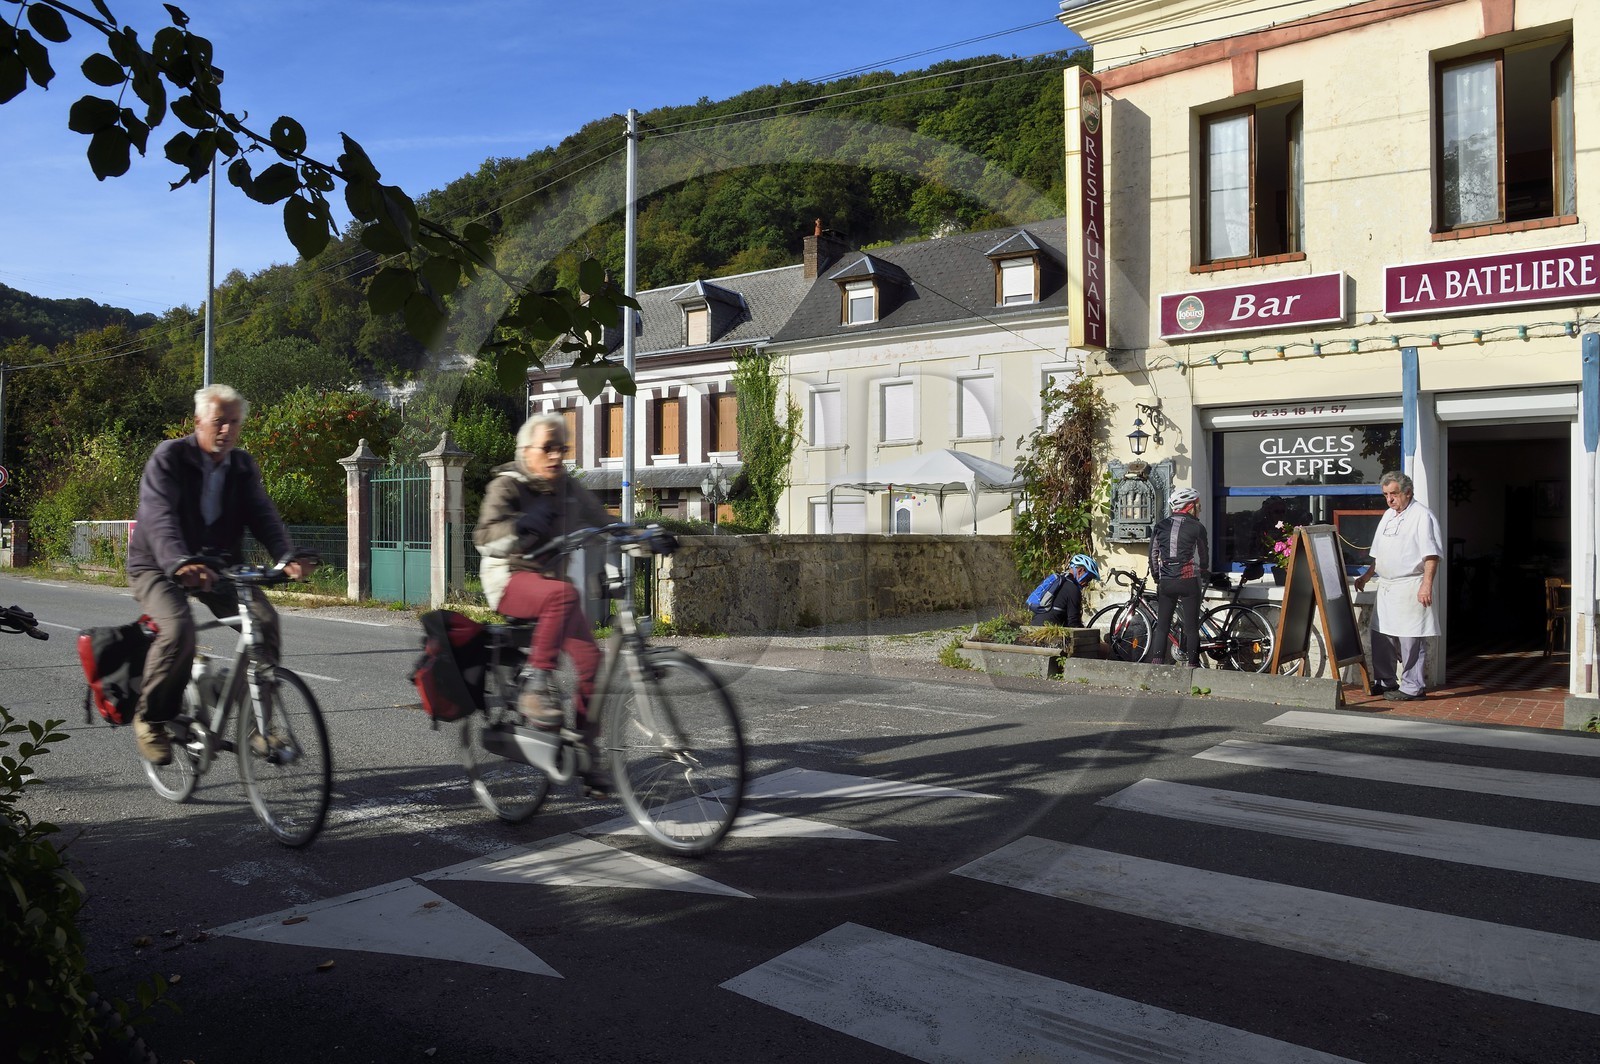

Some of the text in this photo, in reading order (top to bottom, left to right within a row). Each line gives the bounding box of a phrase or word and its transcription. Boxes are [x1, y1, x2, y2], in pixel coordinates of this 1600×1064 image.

[1085, 135, 1100, 341] RESTAURANT
[1399, 254, 1599, 304] LA BATELIERE
[1228, 293, 1303, 321] Bar
[1252, 404, 1347, 418] 02 35 18 17 57
[1259, 434, 1355, 455] GLACES
[1261, 457, 1353, 477] CREPES
